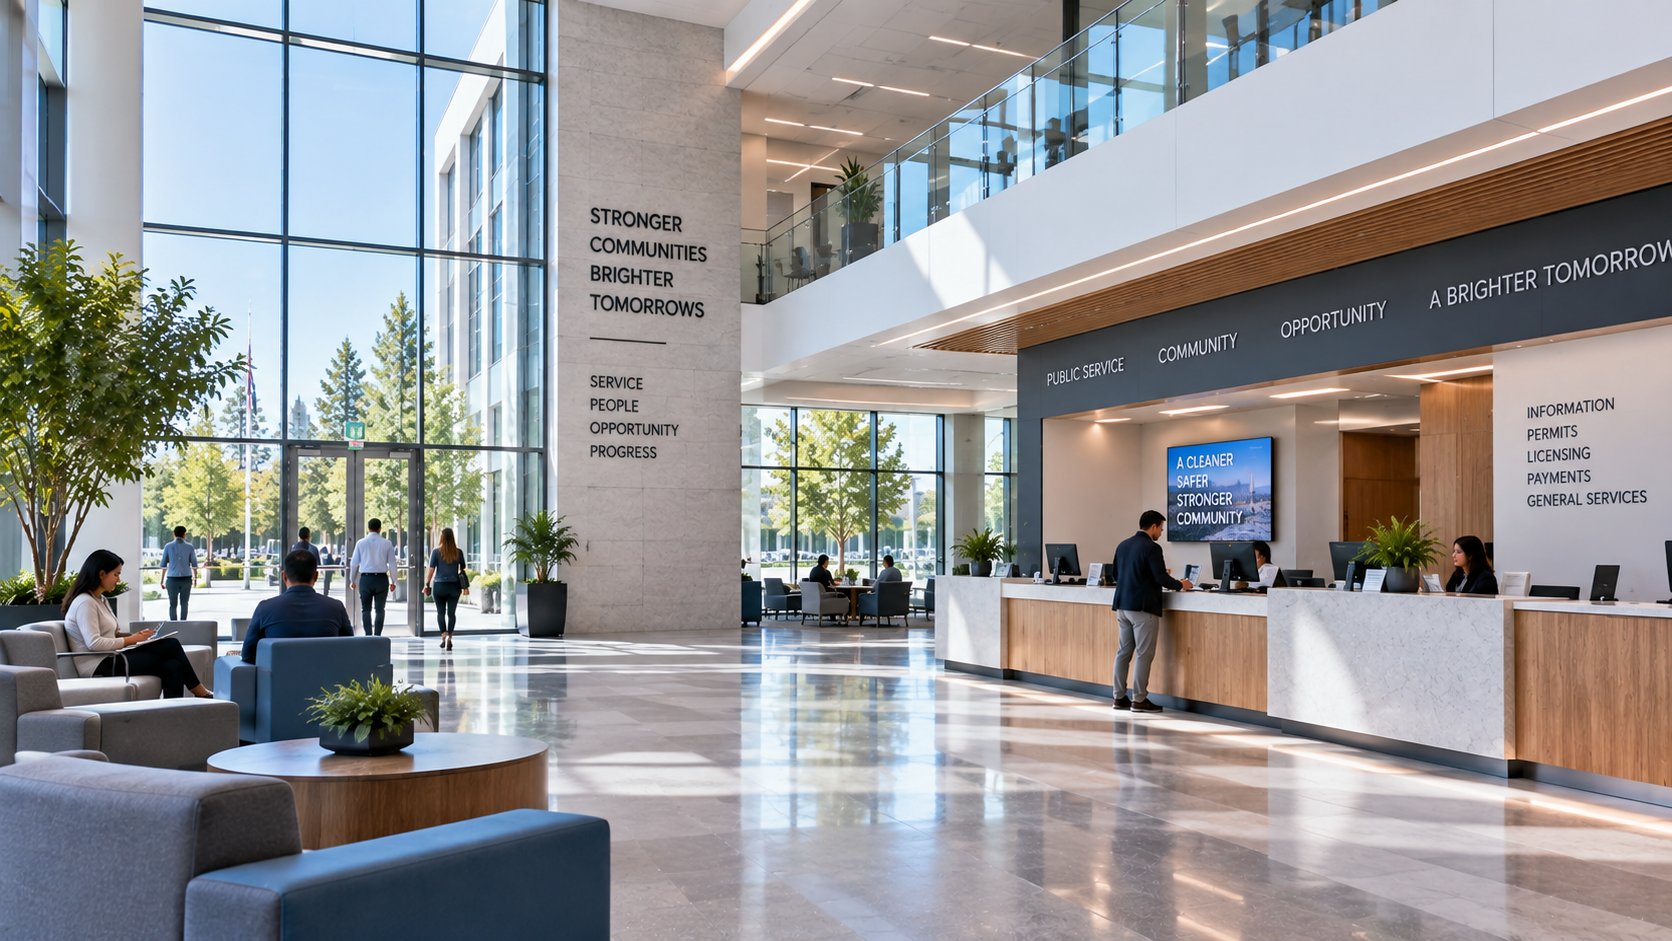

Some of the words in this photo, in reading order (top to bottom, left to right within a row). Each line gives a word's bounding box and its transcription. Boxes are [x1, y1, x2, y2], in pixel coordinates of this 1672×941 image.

[590, 207, 683, 233] STRONGER
[589, 236, 708, 263] COMMUNITIES
[590, 264, 674, 288] BRIGHTER
[1429, 289, 1442, 309] A
[1447, 269, 1538, 306] BRIGHTER
[1542, 239, 1672, 286] TOMORROW
[589, 293, 705, 318] TOMORROWS
[1280, 300, 1388, 339] OPPORTUNITY
[1157, 332, 1239, 364] COMMUNITY
[1047, 366, 1081, 387] PUBLIC
[1082, 357, 1125, 378] SERVICE
[590, 374, 644, 390] SERVICE
[590, 398, 639, 413] PEOPLE
[1527, 397, 1615, 419] INFORMATION
[589, 421, 680, 437] OPPORTUNITY
[1527, 424, 1579, 441] PERMITS
[590, 444, 657, 459] PROGRESS
[1527, 446, 1591, 463] LICENSING
[1176, 456, 1184, 470] A
[1186, 452, 1234, 469] CLEANER
[1177, 474, 1208, 489] SAFER
[1527, 469, 1592, 485] PAYMENTS
[1177, 491, 1233, 507] STRONGER
[1526, 493, 1583, 507] GENERAL
[1586, 489, 1648, 505] SERVICES
[1176, 510, 1243, 526] COMMUNITY
